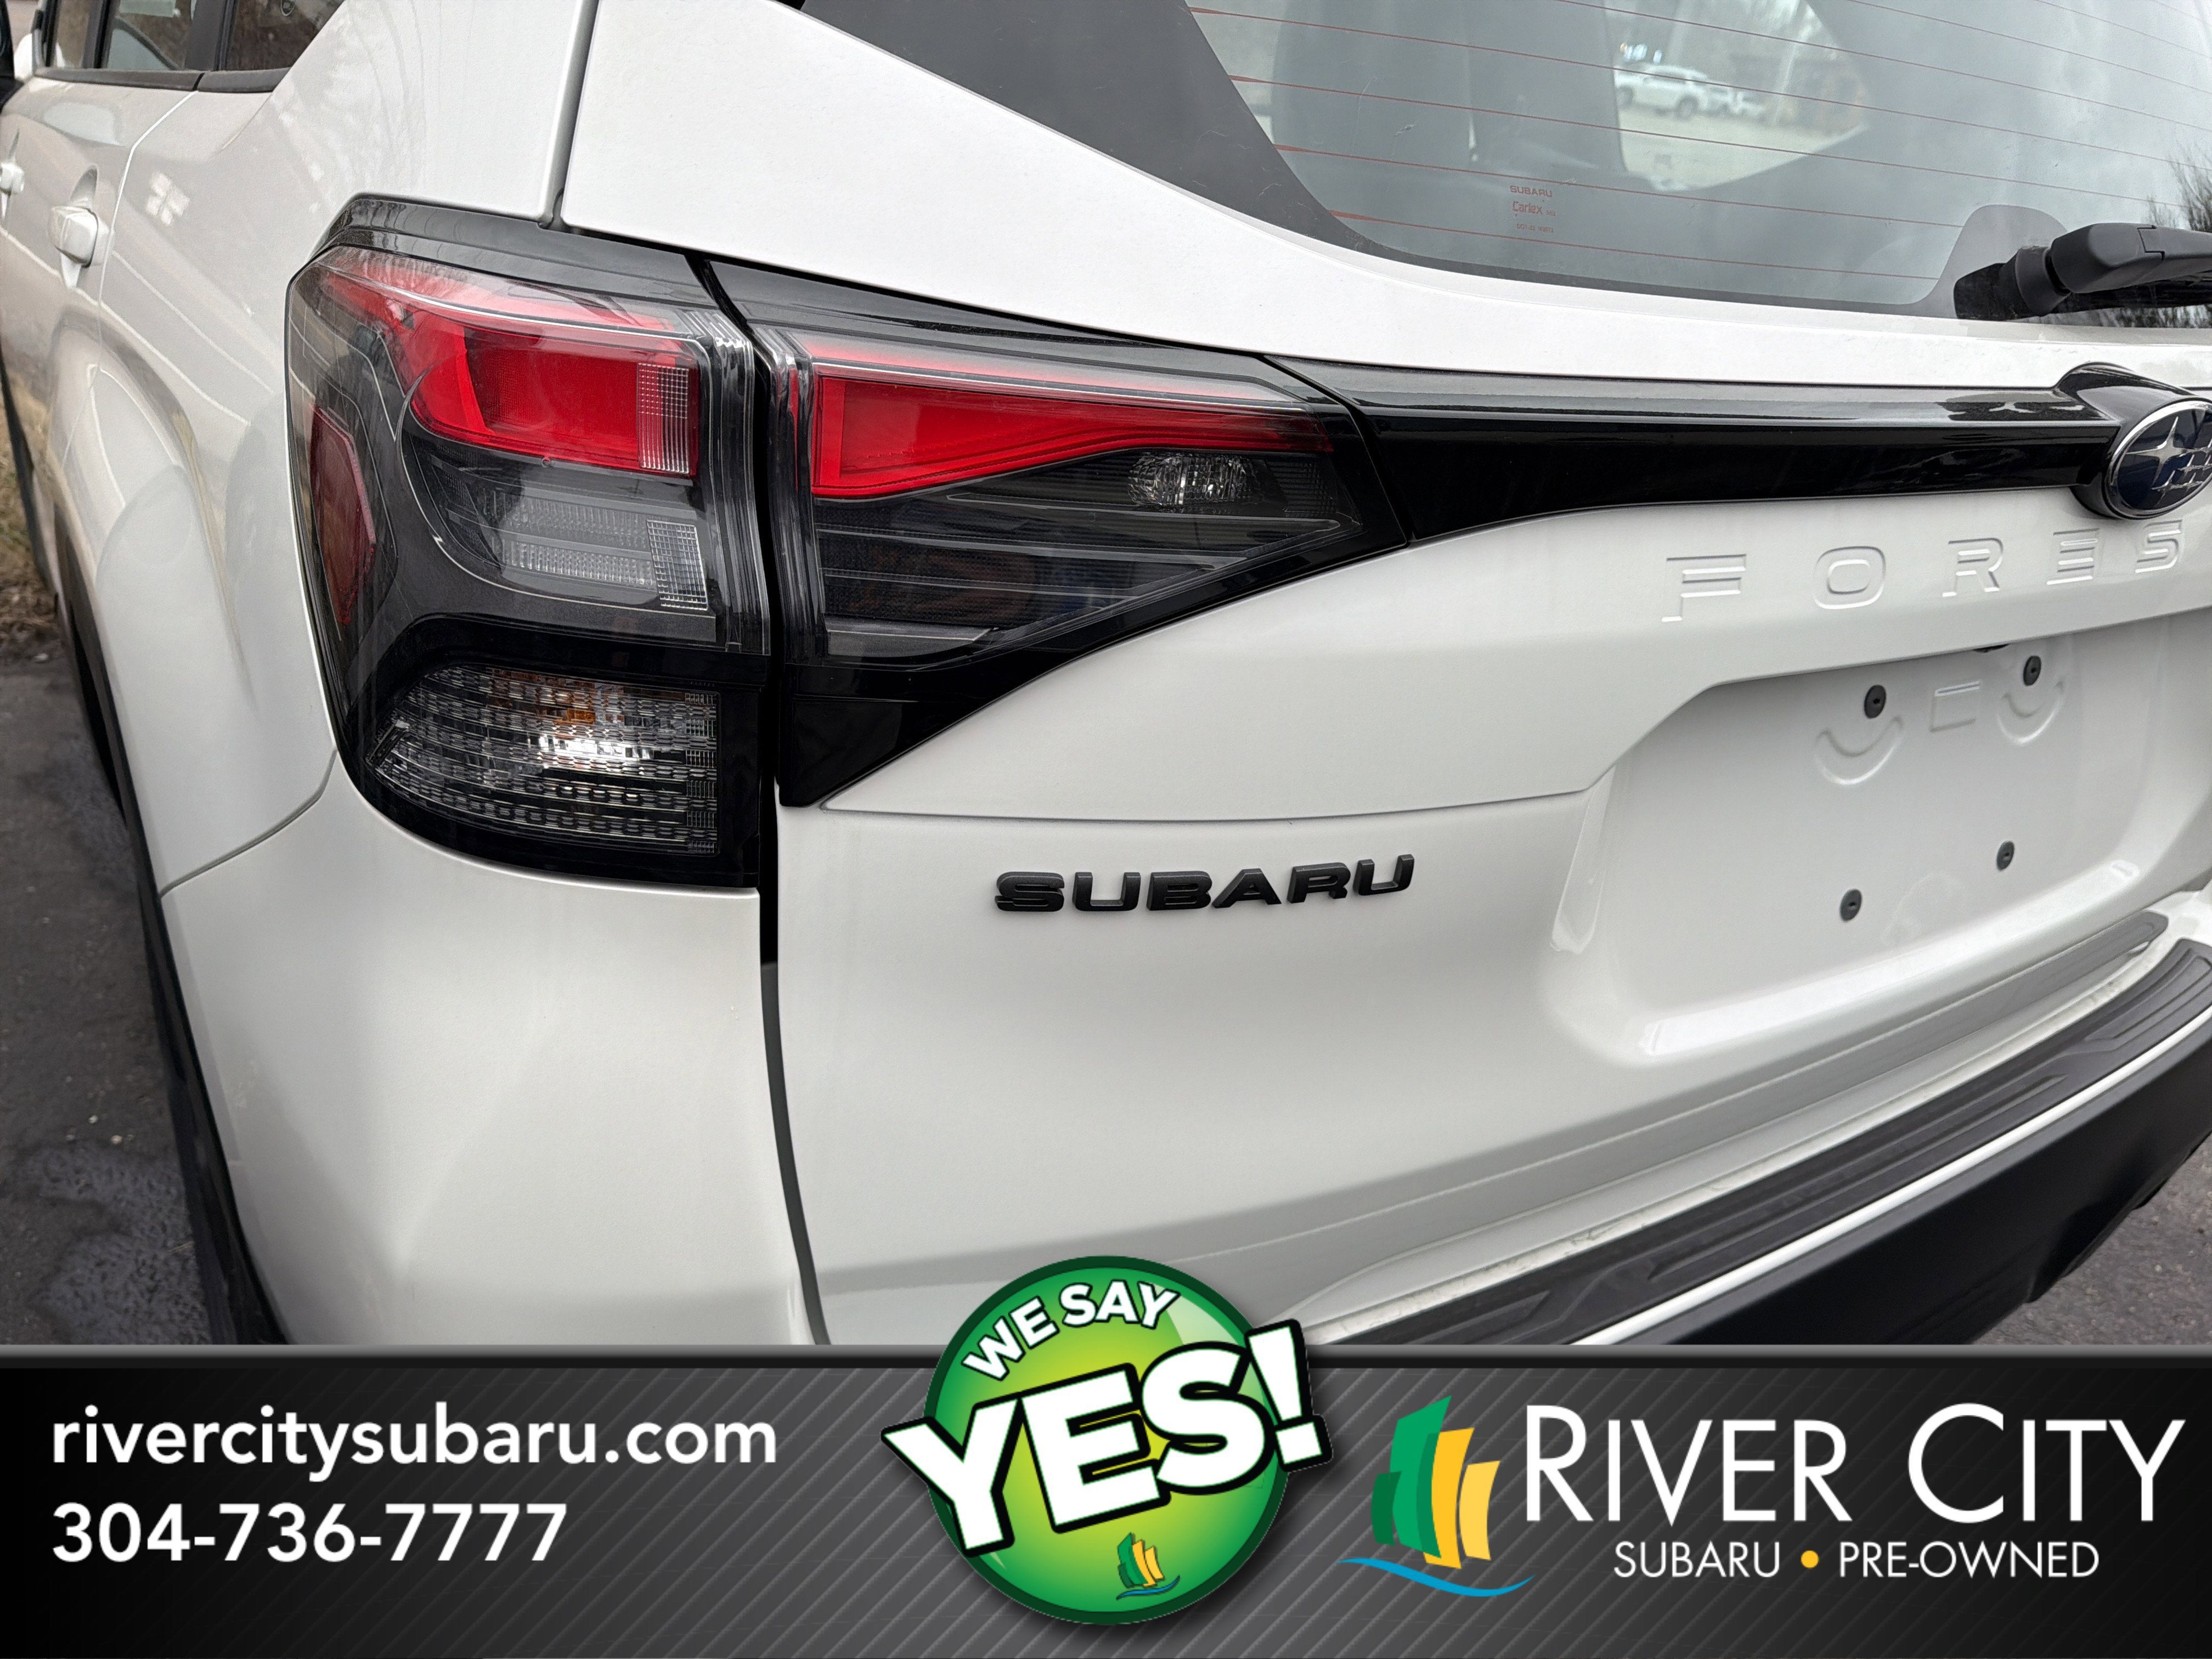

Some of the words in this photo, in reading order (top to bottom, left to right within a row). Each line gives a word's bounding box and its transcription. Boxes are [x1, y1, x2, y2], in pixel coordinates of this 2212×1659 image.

[1510, 185, 1553, 198] SUBARU
[1512, 201, 1543, 215] Carlex
[1661, 518, 2183, 623] FORES
[995, 855, 1414, 912] SUBARU
